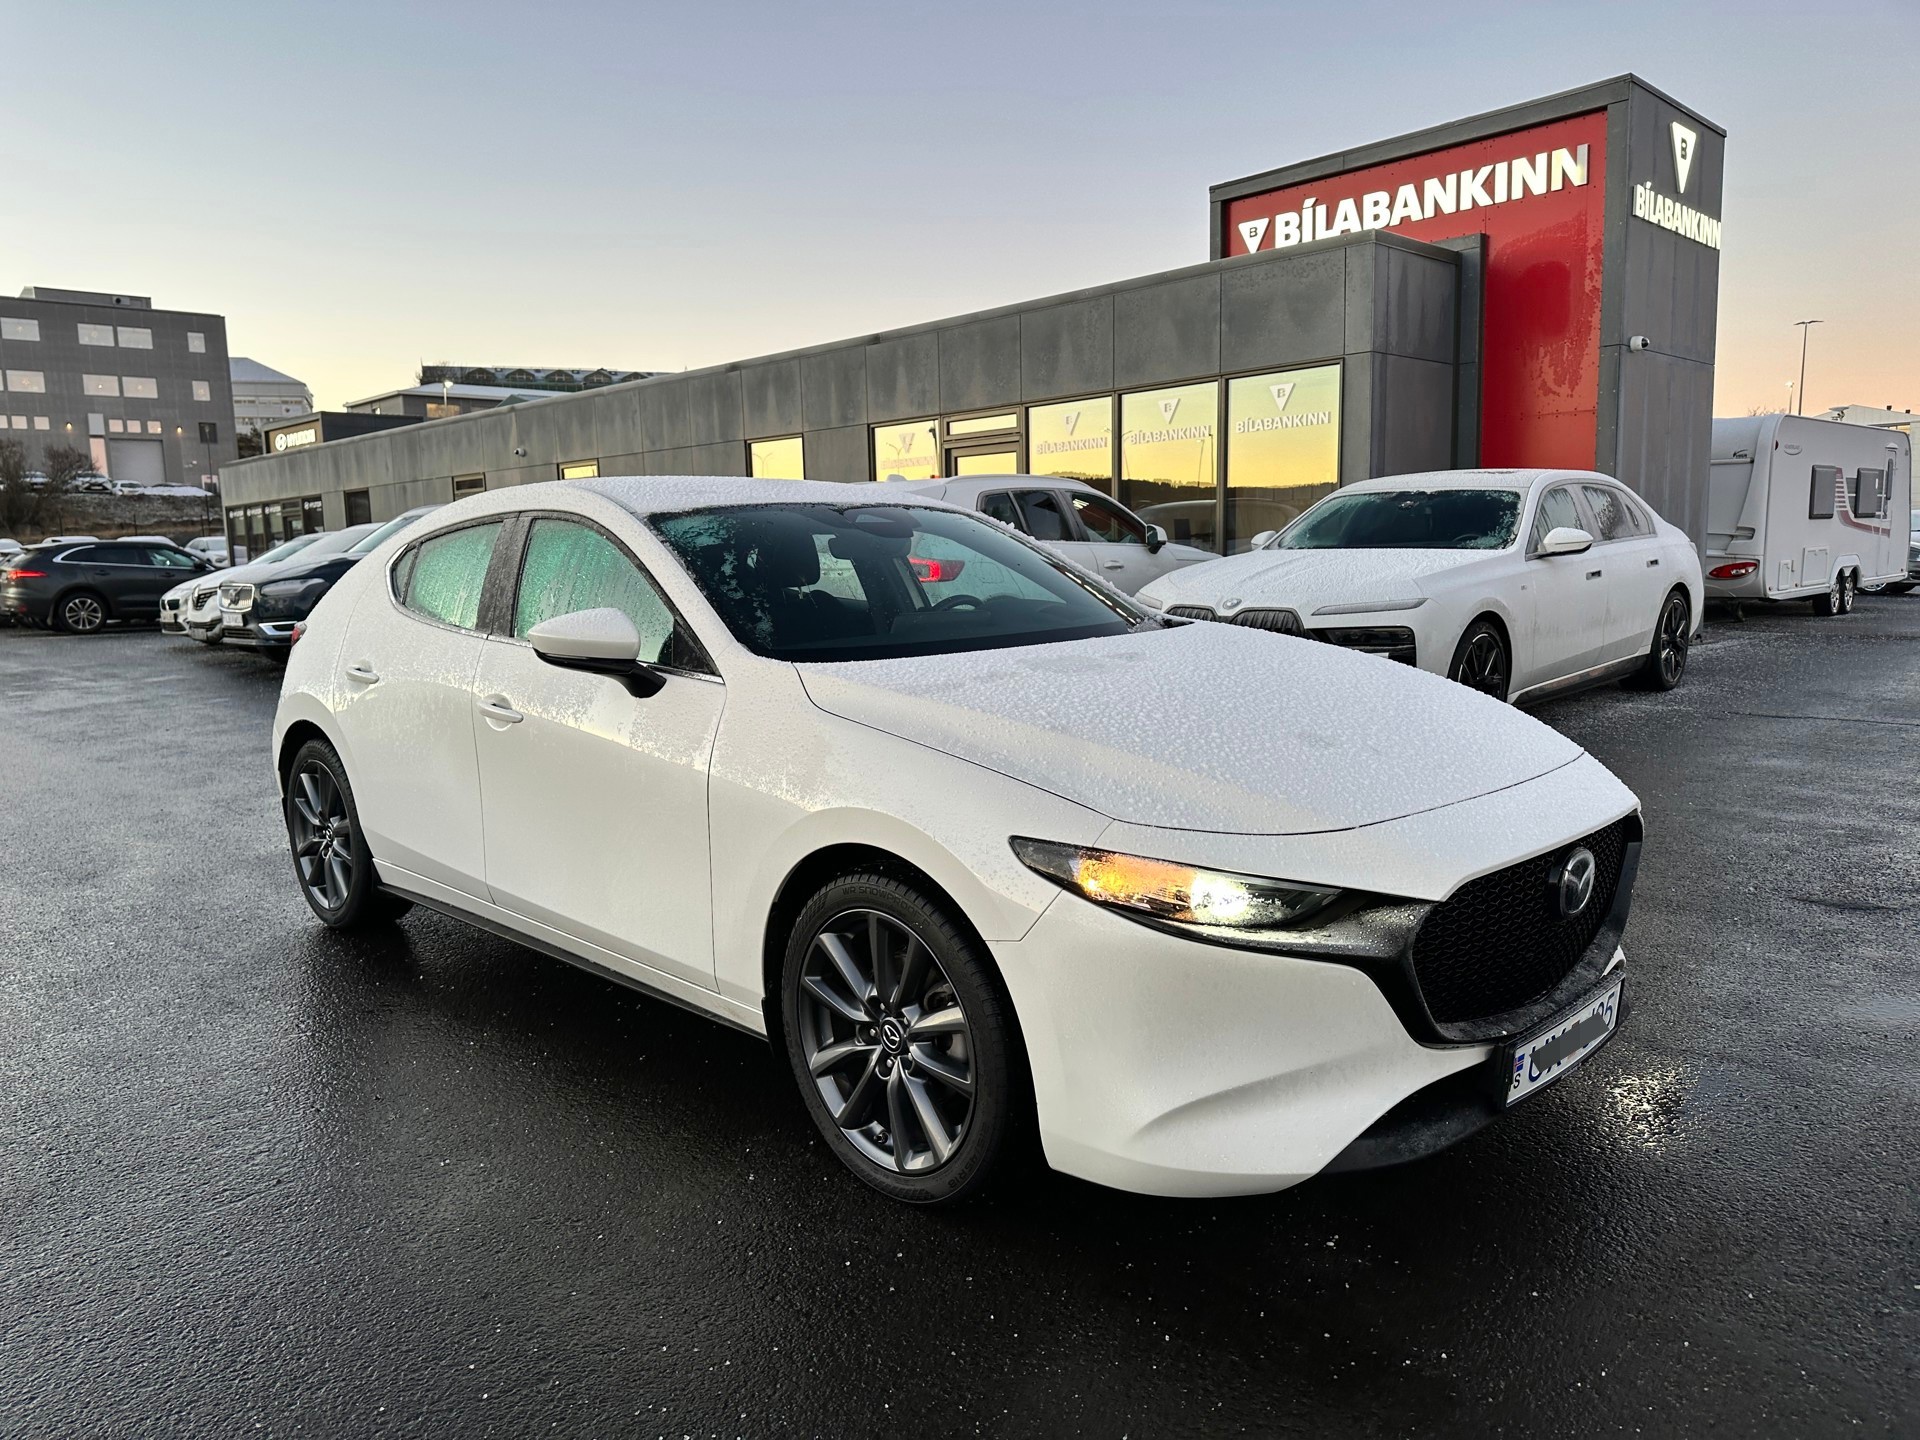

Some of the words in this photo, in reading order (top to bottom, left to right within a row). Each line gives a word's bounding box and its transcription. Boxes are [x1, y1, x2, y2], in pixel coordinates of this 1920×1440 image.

[1275, 144, 1589, 248] BÍLABANKINN
[1632, 181, 1721, 250] BÍLABANKINN
[1236, 411, 1331, 433] BÍLABANKINN
[1036, 436, 1108, 455] BÍLABANKINN
[1130, 425, 1212, 445] BÍLABANKINN
